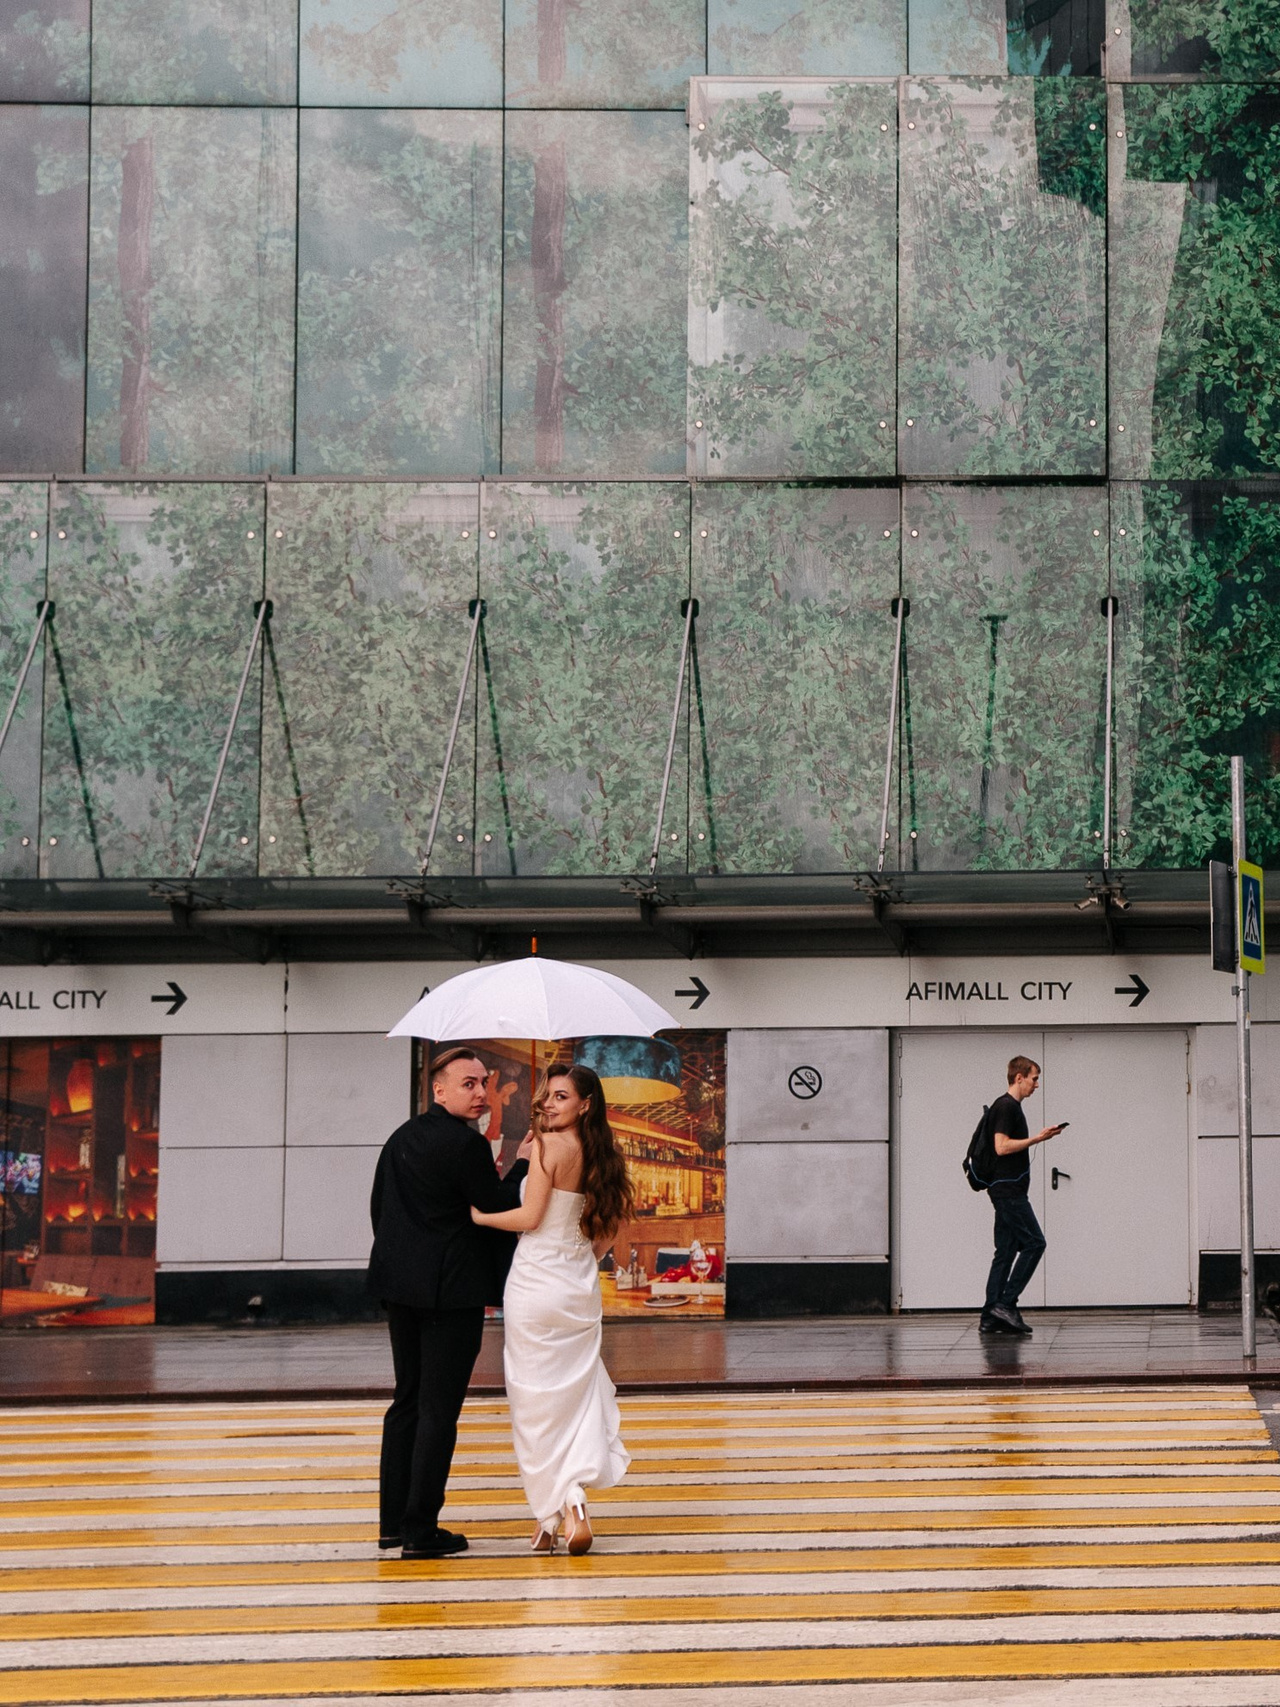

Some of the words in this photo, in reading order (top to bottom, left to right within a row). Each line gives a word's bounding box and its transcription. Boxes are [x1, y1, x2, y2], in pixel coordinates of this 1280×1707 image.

[53, 990, 108, 1010] CITY
[905, 981, 1009, 1001] AFIMALL
[1020, 981, 1073, 1001] CITY
